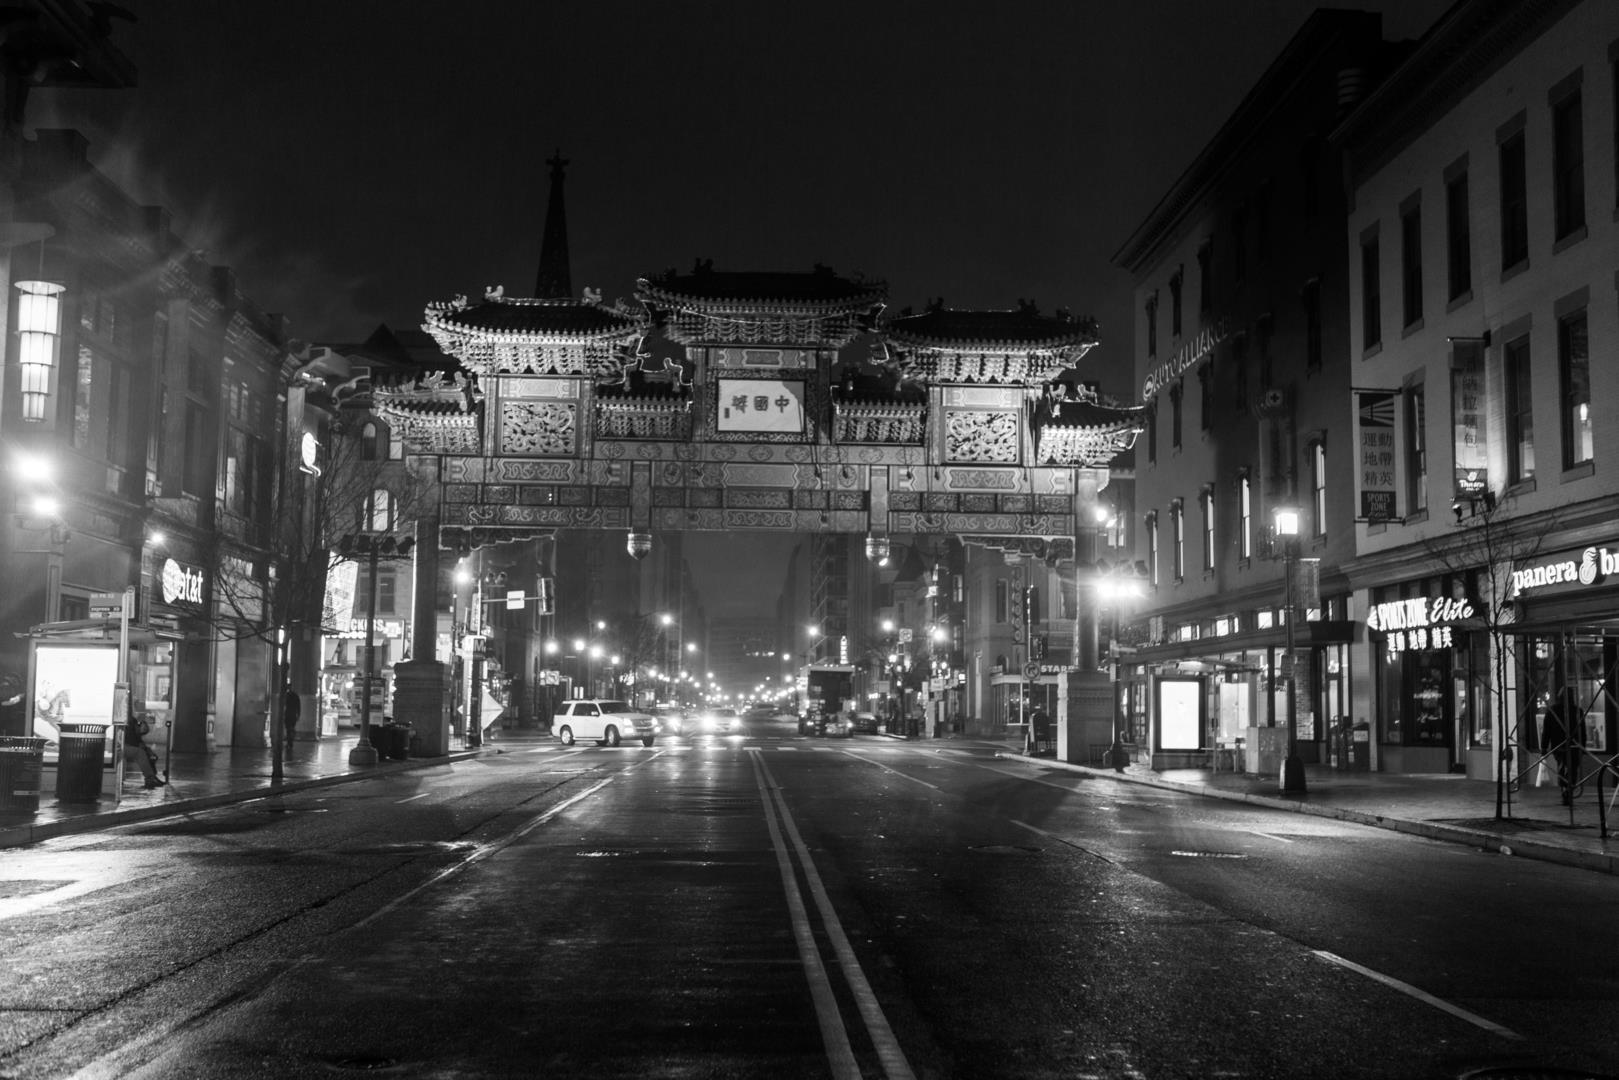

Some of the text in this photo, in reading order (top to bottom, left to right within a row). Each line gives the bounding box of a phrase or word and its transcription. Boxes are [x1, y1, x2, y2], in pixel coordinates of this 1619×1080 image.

[1367, 493, 1390, 502] SPORTS
[1370, 502, 1387, 512] ZONE
[1512, 561, 1578, 597] panera
[1378, 596, 1474, 631] SPORTS ZONE Elite
